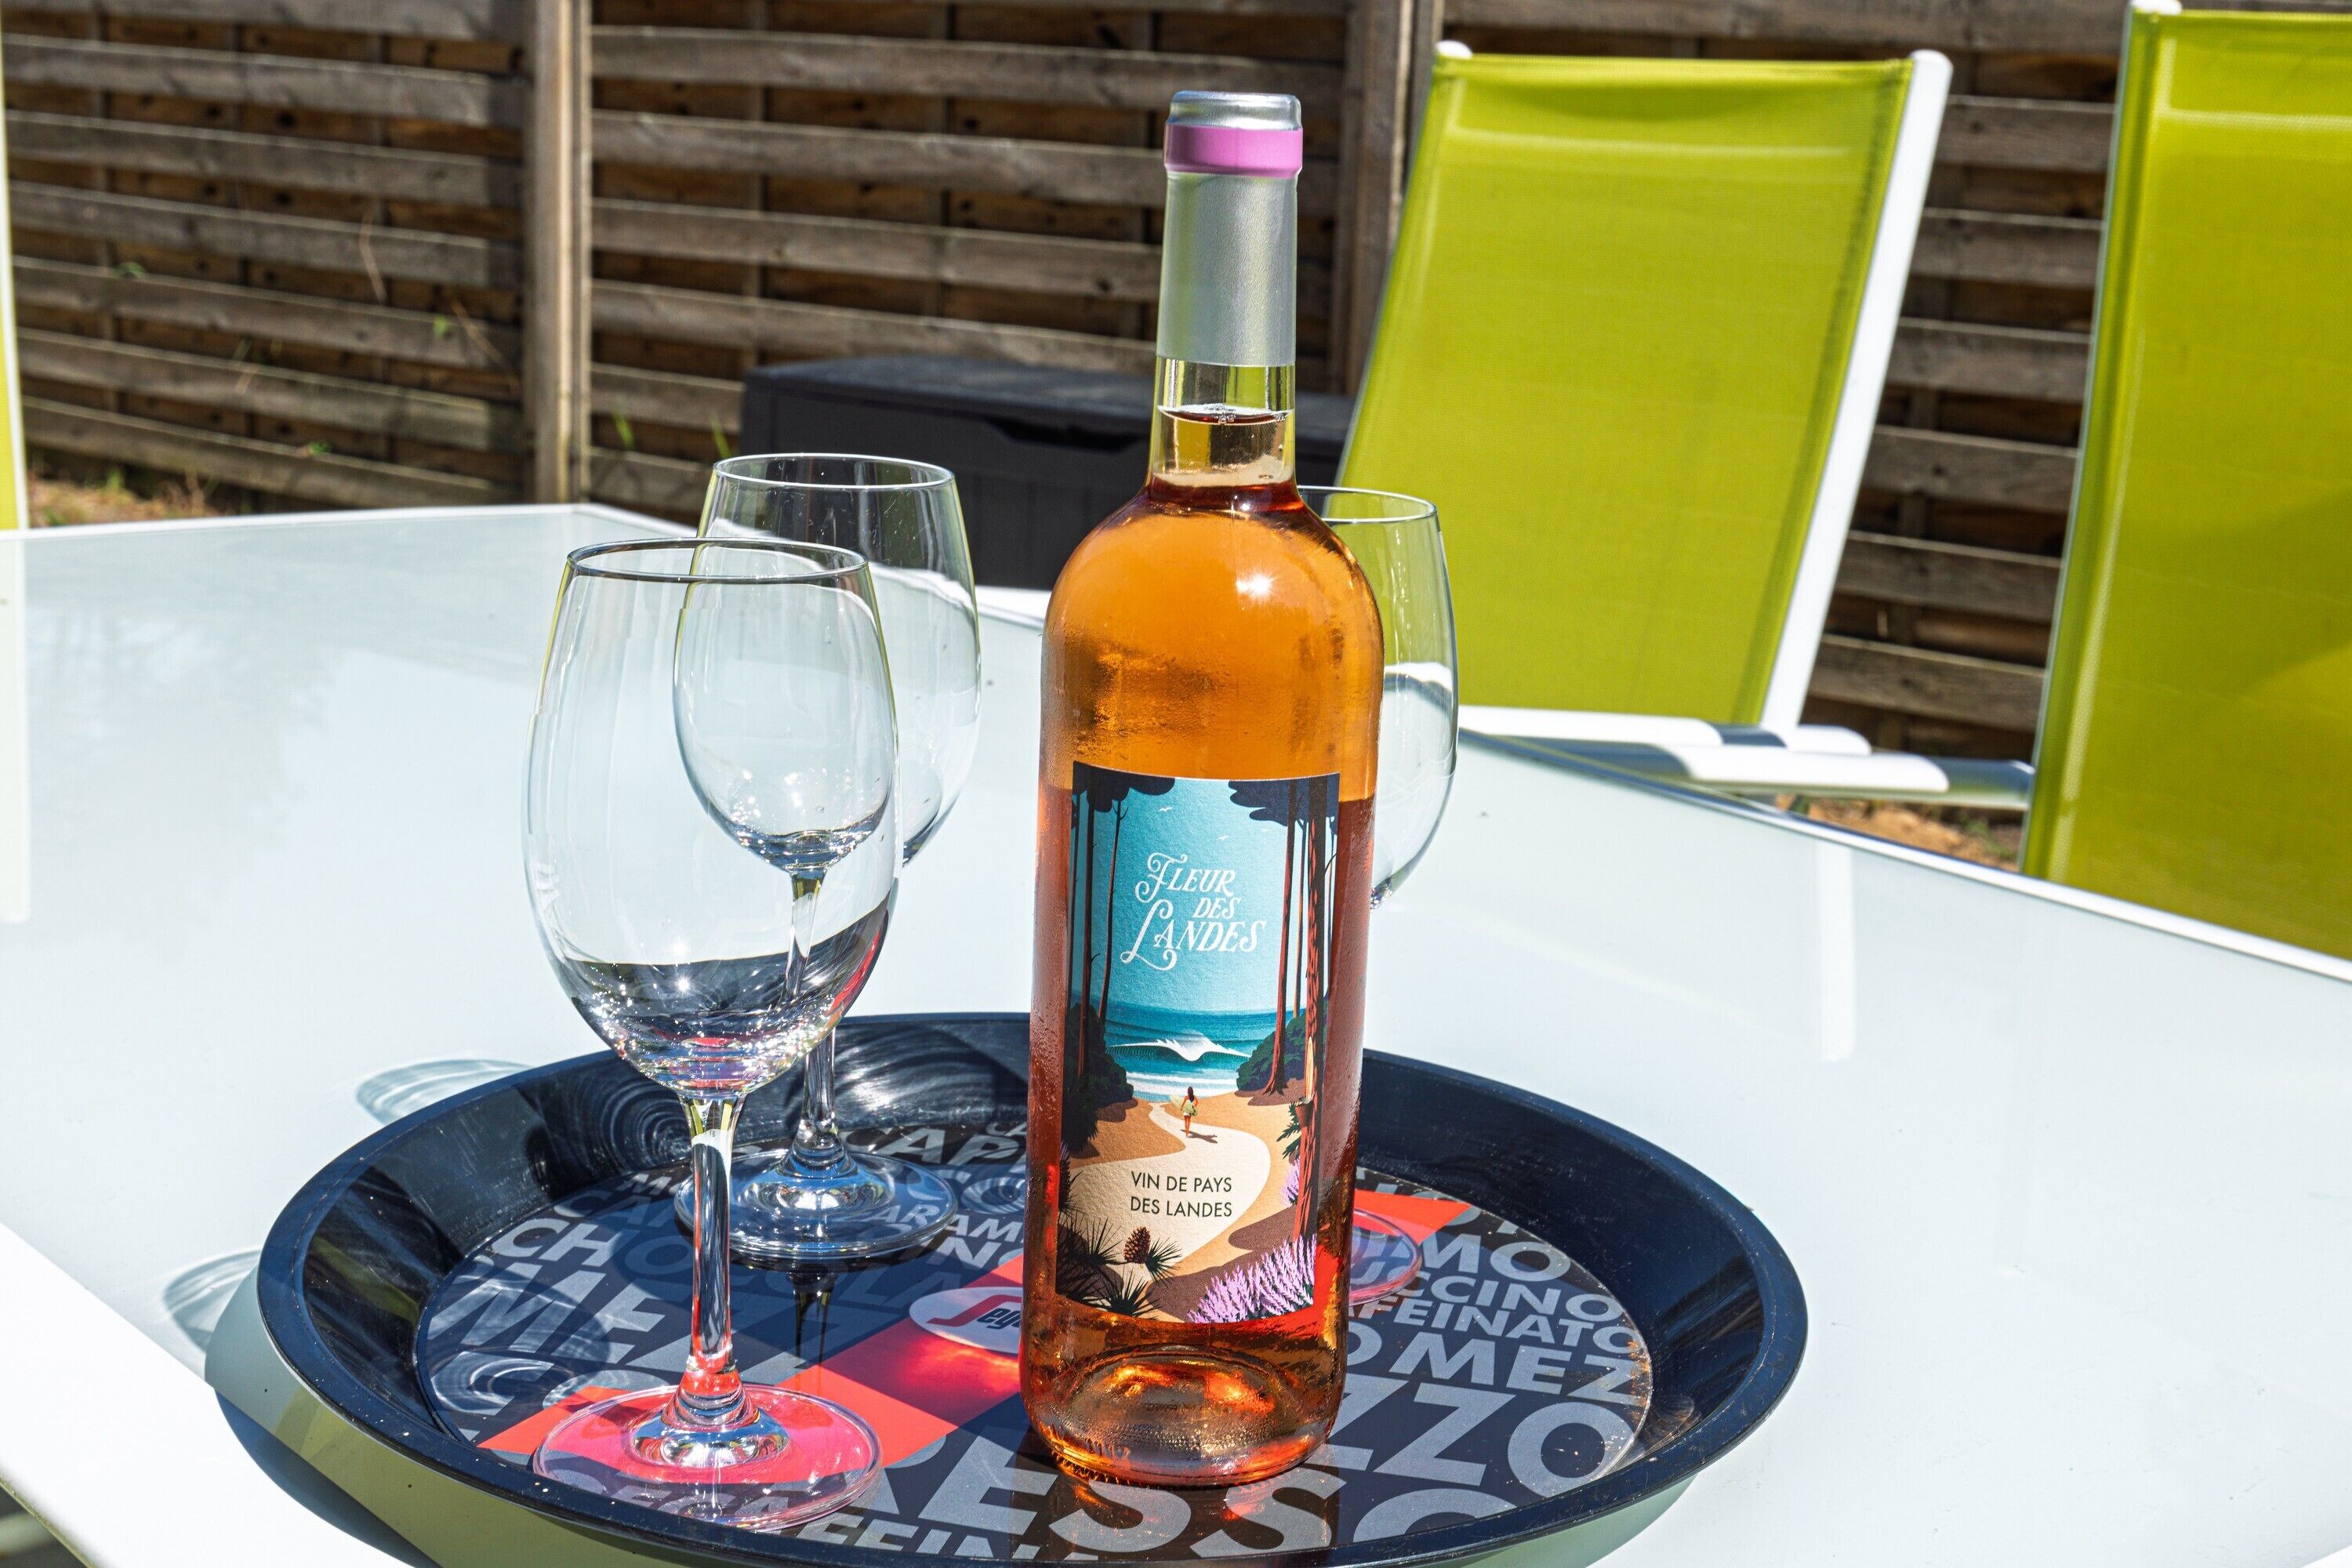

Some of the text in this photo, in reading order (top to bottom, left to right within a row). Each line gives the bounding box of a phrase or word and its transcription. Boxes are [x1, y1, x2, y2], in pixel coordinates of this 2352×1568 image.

[1134, 851, 1236, 903] FLEUR
[1191, 896, 1242, 920] DES
[1120, 898, 1268, 971] LANDES
[1131, 1171, 1232, 1192] VIN DE PAYS
[1130, 1196, 1232, 1218] DES LANDES
[1348, 1295, 1643, 1355] FEINATO
